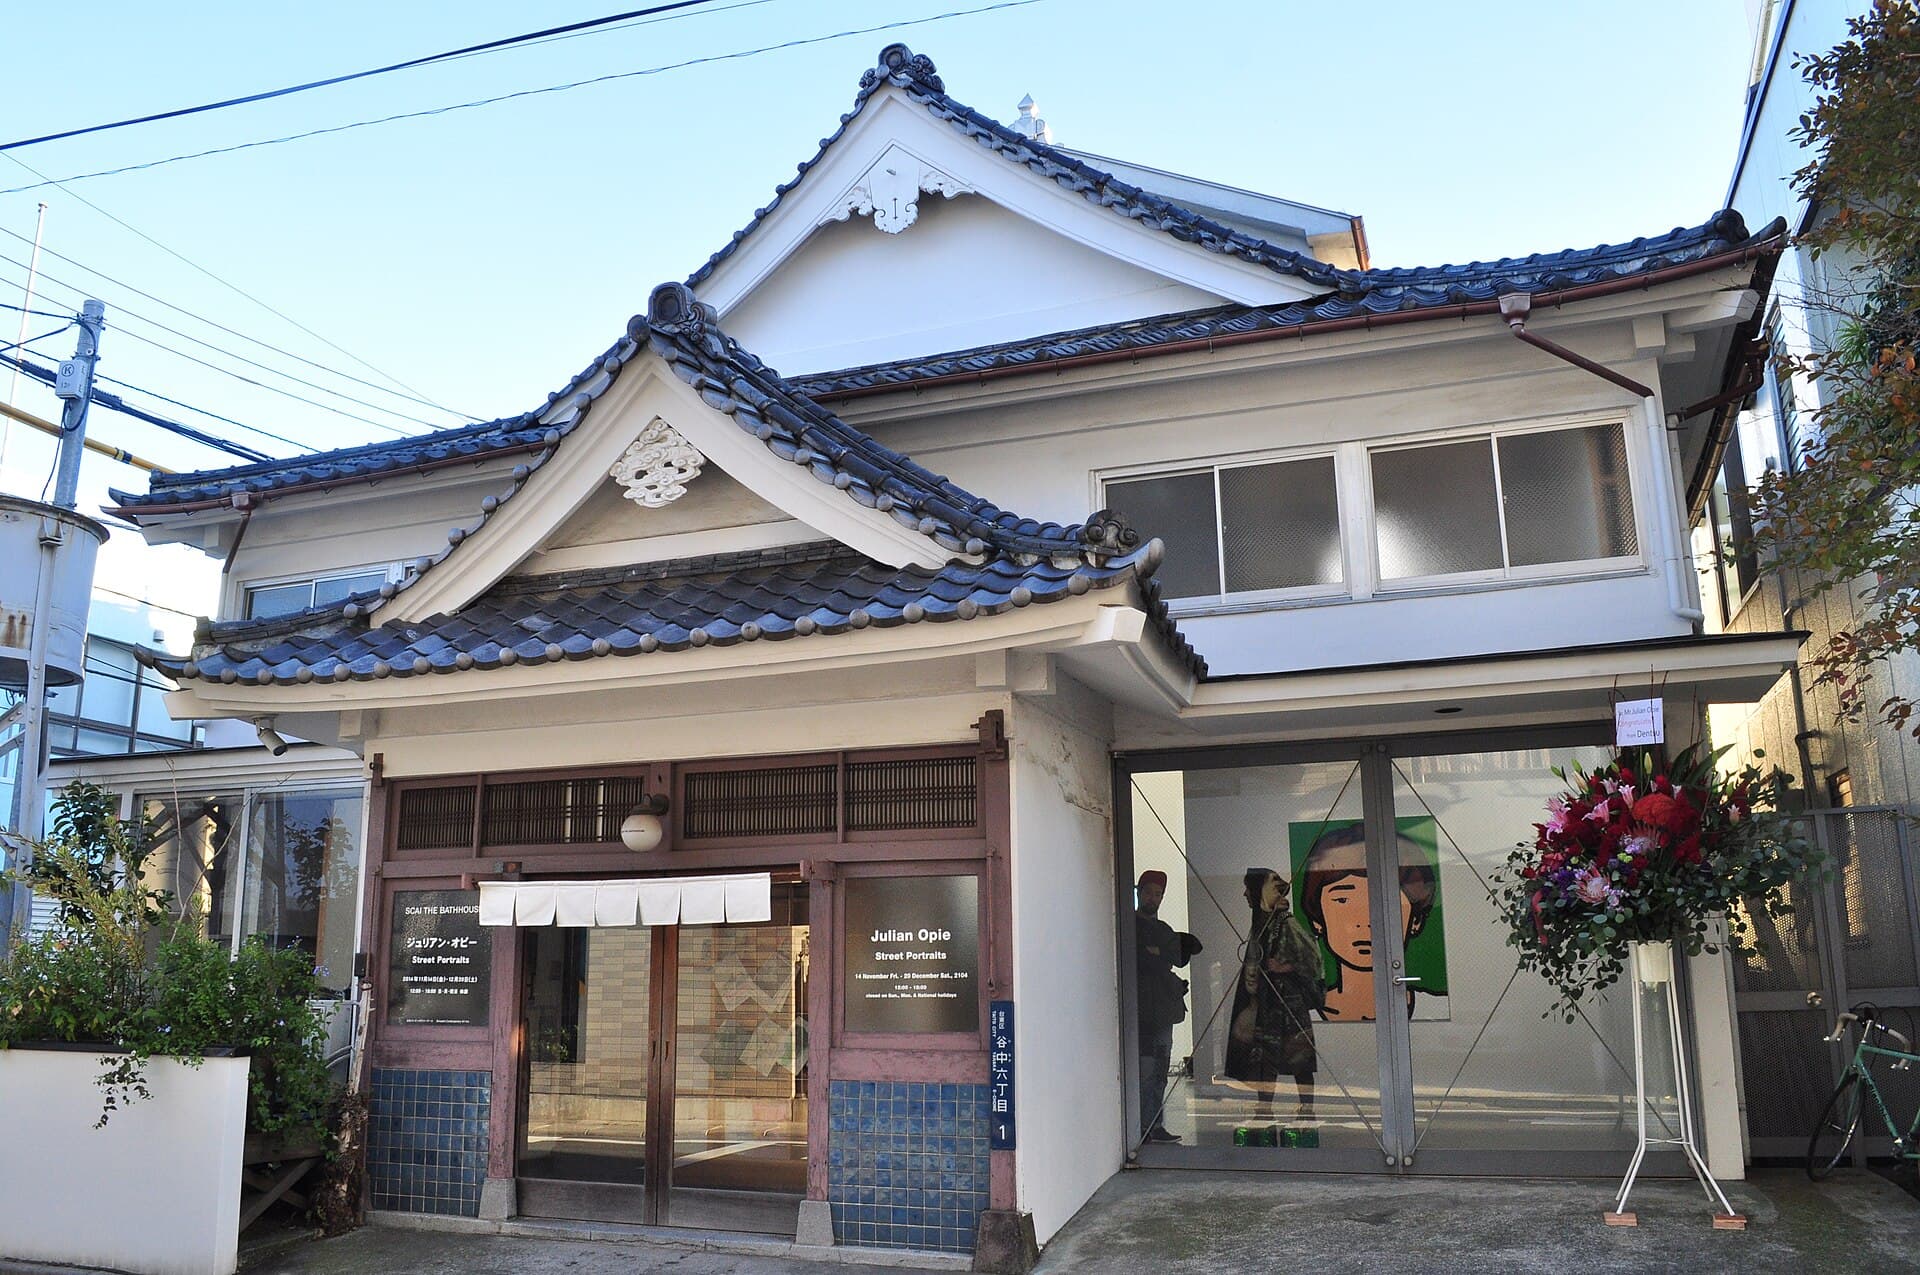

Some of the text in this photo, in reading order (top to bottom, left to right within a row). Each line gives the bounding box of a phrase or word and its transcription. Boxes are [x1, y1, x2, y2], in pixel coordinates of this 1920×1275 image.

[1637, 730, 1660, 738] Dentu
[405, 906, 480, 915] SCAI THE BATHHOUS
[871, 928, 951, 943] Julian Opie
[406, 936, 477, 948] ジュリアン・オピー
[412, 956, 470, 964] Street Portraits
[875, 951, 947, 961] Street Portraits
[996, 1036, 1008, 1112] 谷中六丁目
[999, 1125, 1006, 1140] 1
